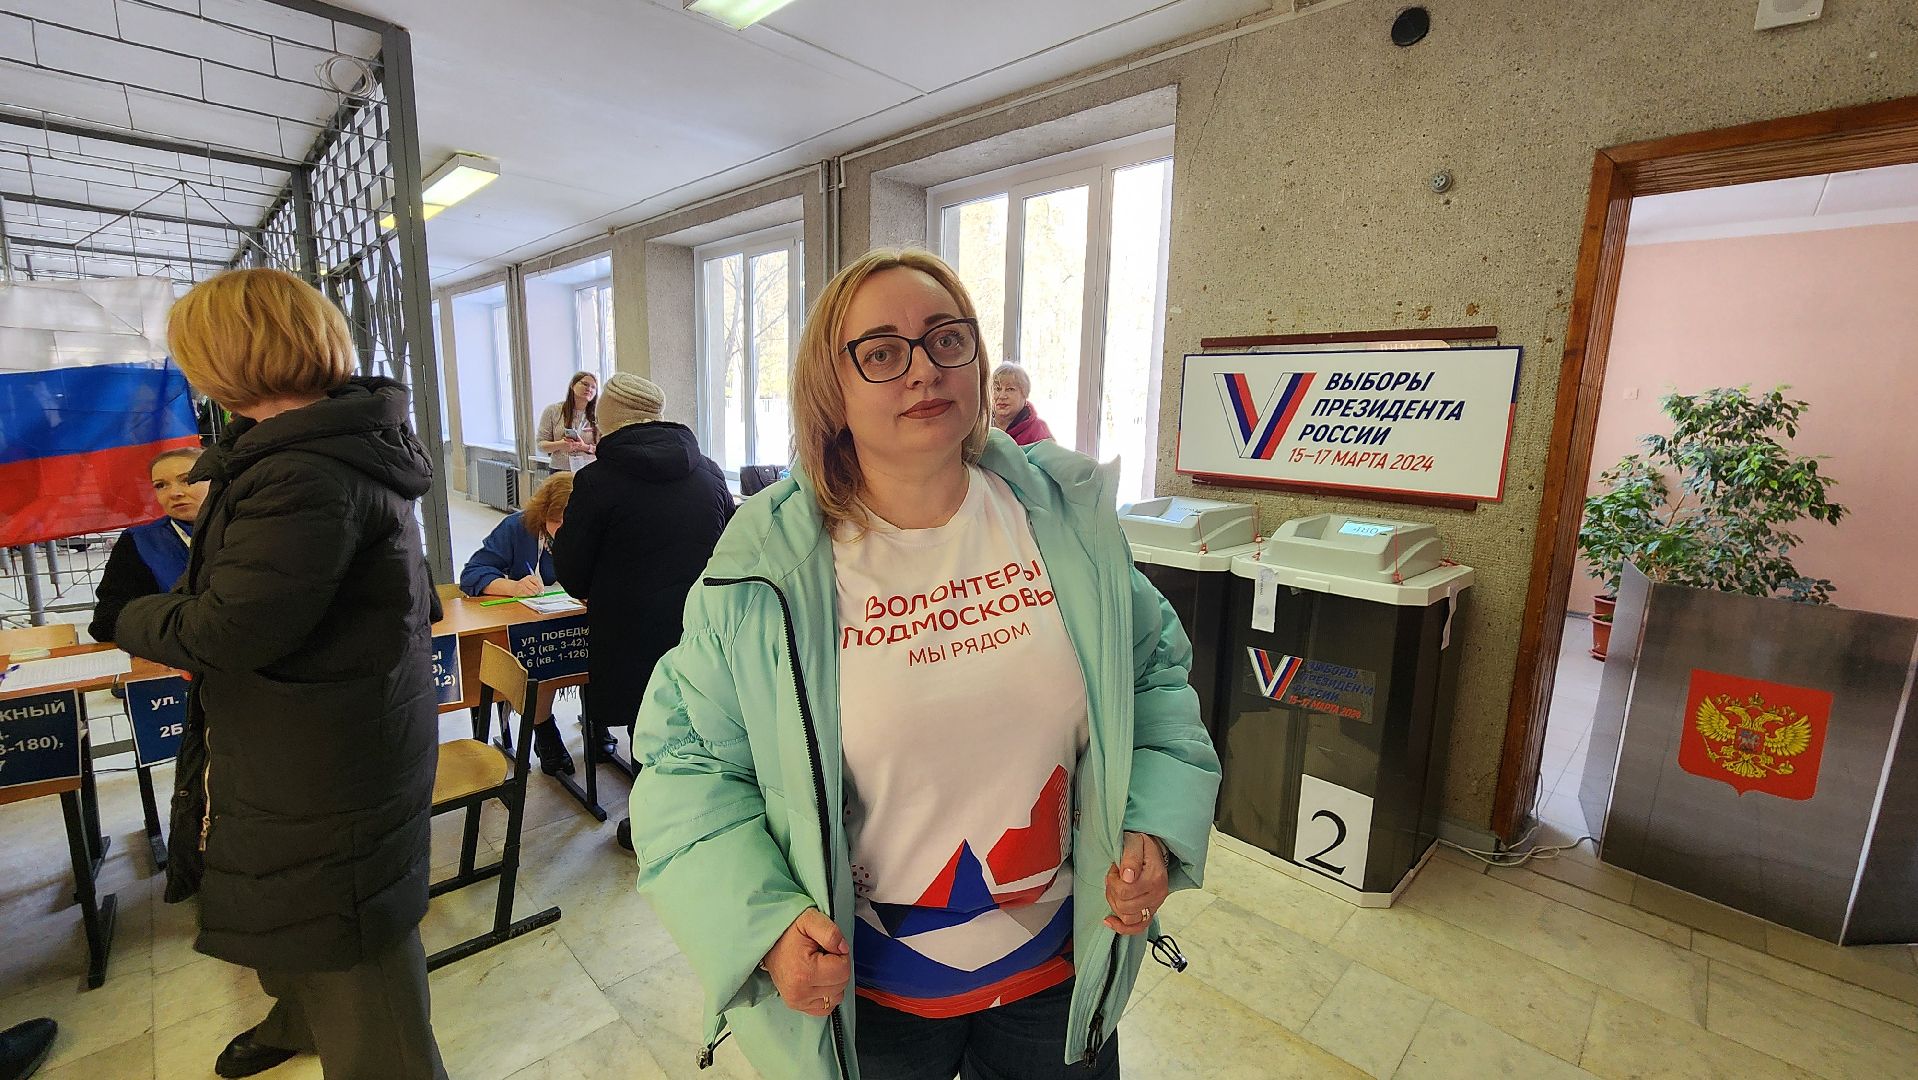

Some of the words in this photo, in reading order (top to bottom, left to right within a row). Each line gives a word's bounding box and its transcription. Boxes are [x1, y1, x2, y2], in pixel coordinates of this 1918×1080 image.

[1325, 372, 1435, 392] ВЫБОРЫ
[1311, 399, 1466, 422] ПРЕЗИДЕНТА
[1298, 425, 1392, 446] РОССИИ
[1332, 452, 1389, 470] МАРТА
[1389, 454, 1434, 473] 2024
[865, 559, 1042, 622] ВОЛОНТЕРЫ
[521, 636, 538, 647] ул.
[541, 626, 590, 641] ПОБЕДЫ
[909, 644, 946, 667] МЫ
[951, 621, 1031, 657] РЯДОМ
[516, 650, 527, 659] д.
[529, 646, 536, 656] 3
[538, 644, 558, 655] (кв.
[526, 659, 533, 668] 6
[536, 656, 555, 668] (кв.
[558, 649, 589, 661] 1-126)
[150, 695, 180, 711] ул.
[1311, 699, 1340, 714] МАРТА
[1340, 706, 1362, 720] 2024
[1305, 809, 1348, 876] 2
